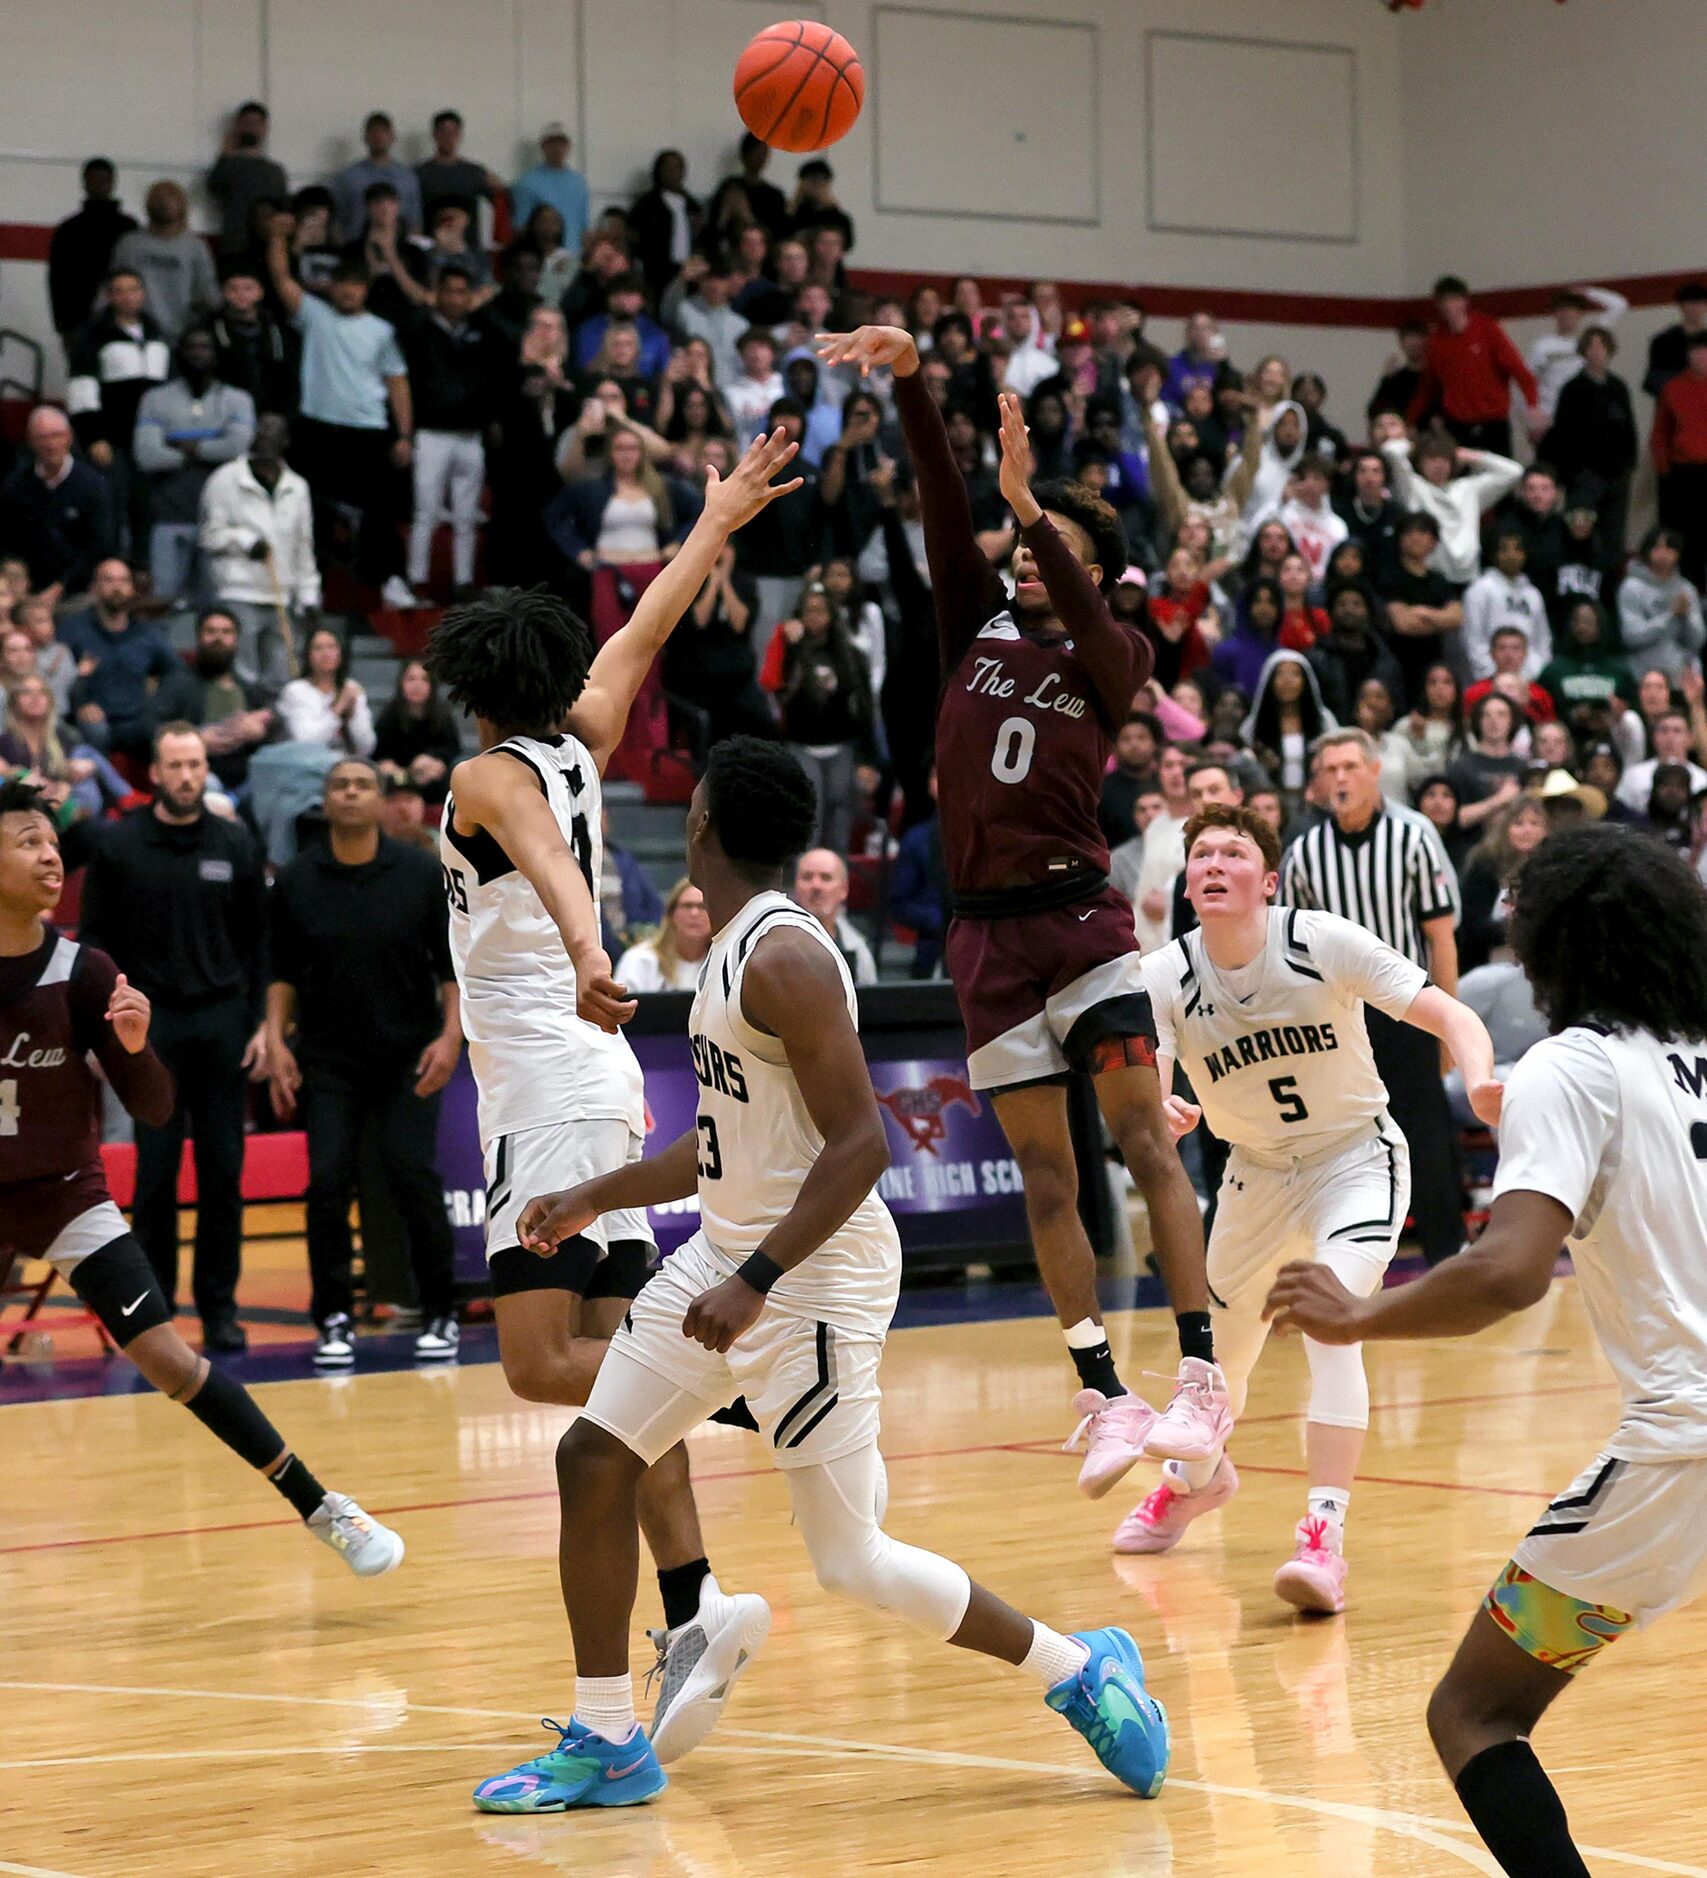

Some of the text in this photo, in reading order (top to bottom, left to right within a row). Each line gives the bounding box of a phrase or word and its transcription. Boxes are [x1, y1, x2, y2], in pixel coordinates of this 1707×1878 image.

[966, 656, 1086, 719] The Lew
[991, 716, 1036, 785] 0
[0, 1032, 67, 1068] Lew
[1203, 1023, 1339, 1084] WARRIORS
[1268, 1075, 1309, 1124] 5
[922, 1160, 977, 1196] HIGH
